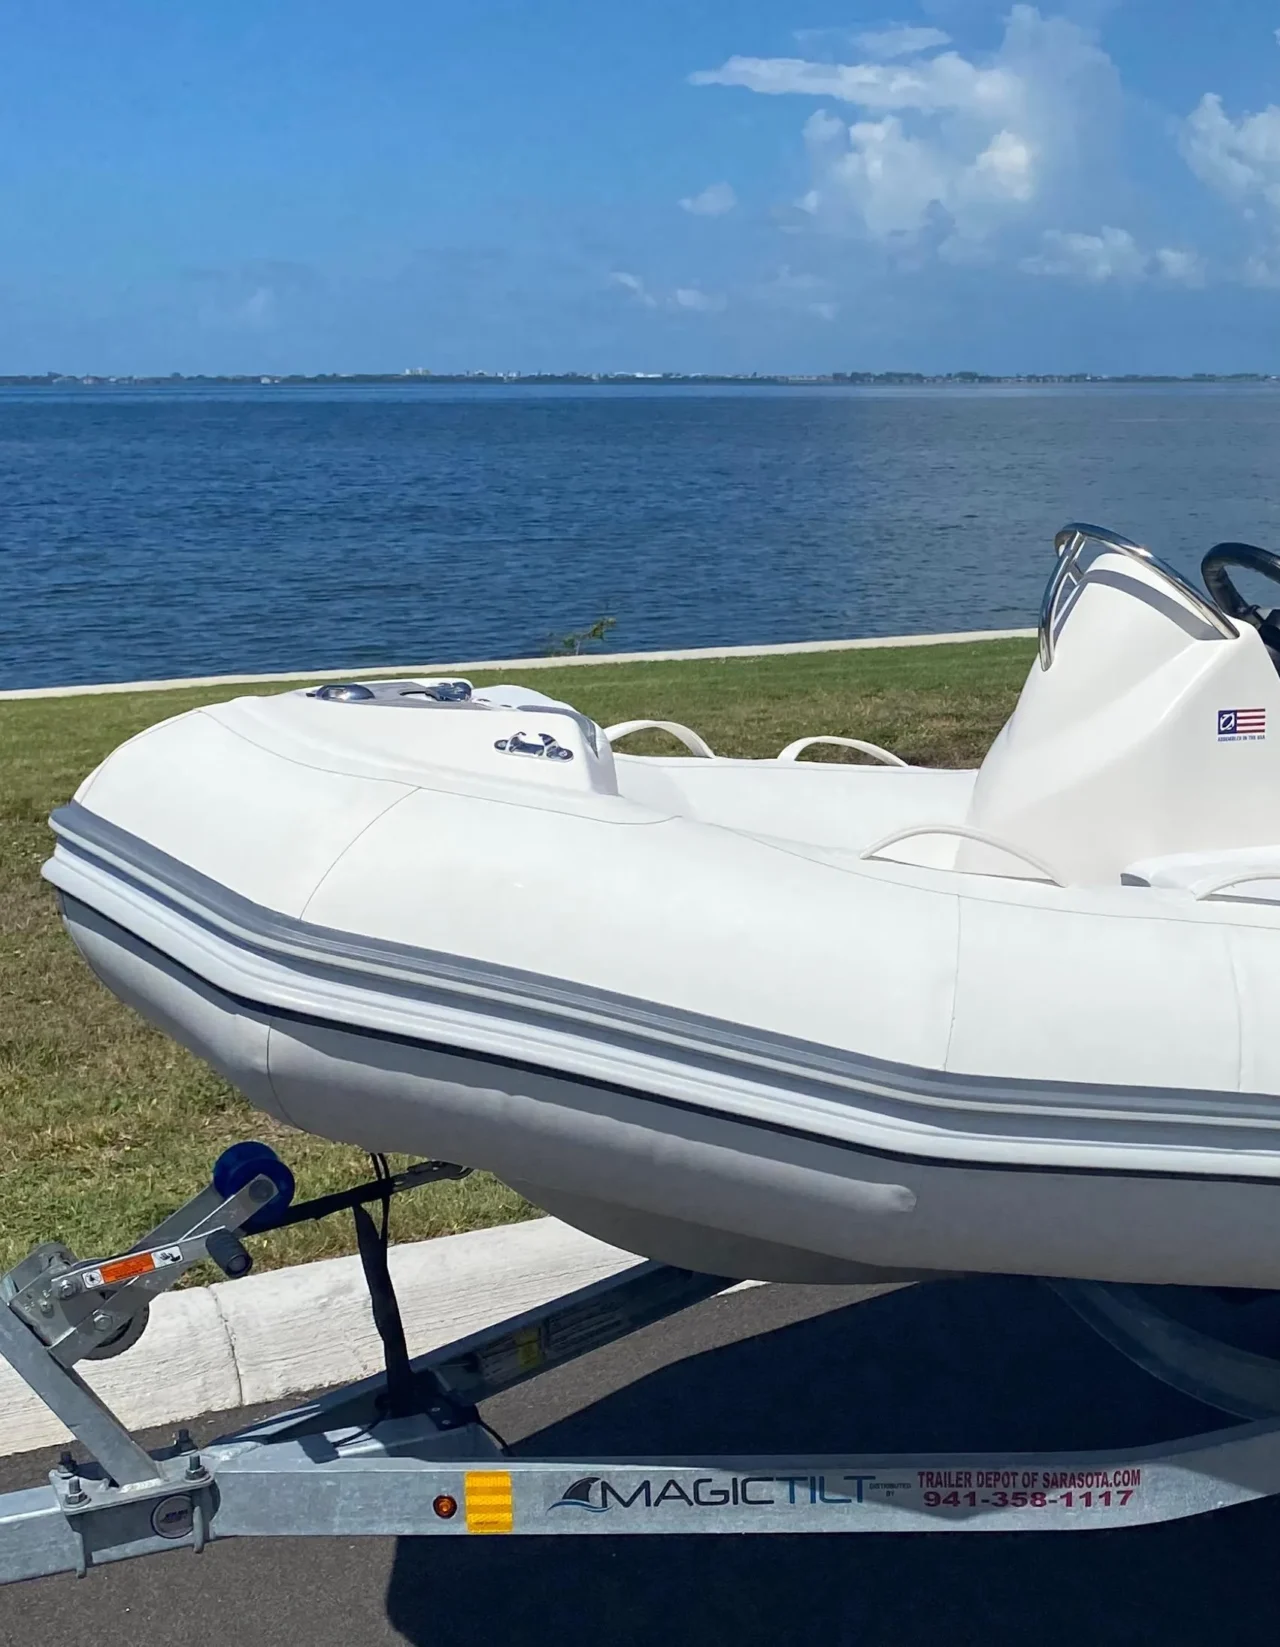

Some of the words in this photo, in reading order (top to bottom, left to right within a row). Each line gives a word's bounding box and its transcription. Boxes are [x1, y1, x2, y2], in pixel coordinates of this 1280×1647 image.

[917, 1471, 972, 1488] TRAILER
[976, 1471, 1018, 1488] DEPOT
[1022, 1471, 1038, 1488] OF
[1042, 1469, 1140, 1489] SARASOTA.COM
[923, 1489, 1134, 1508] 941-358-1117
